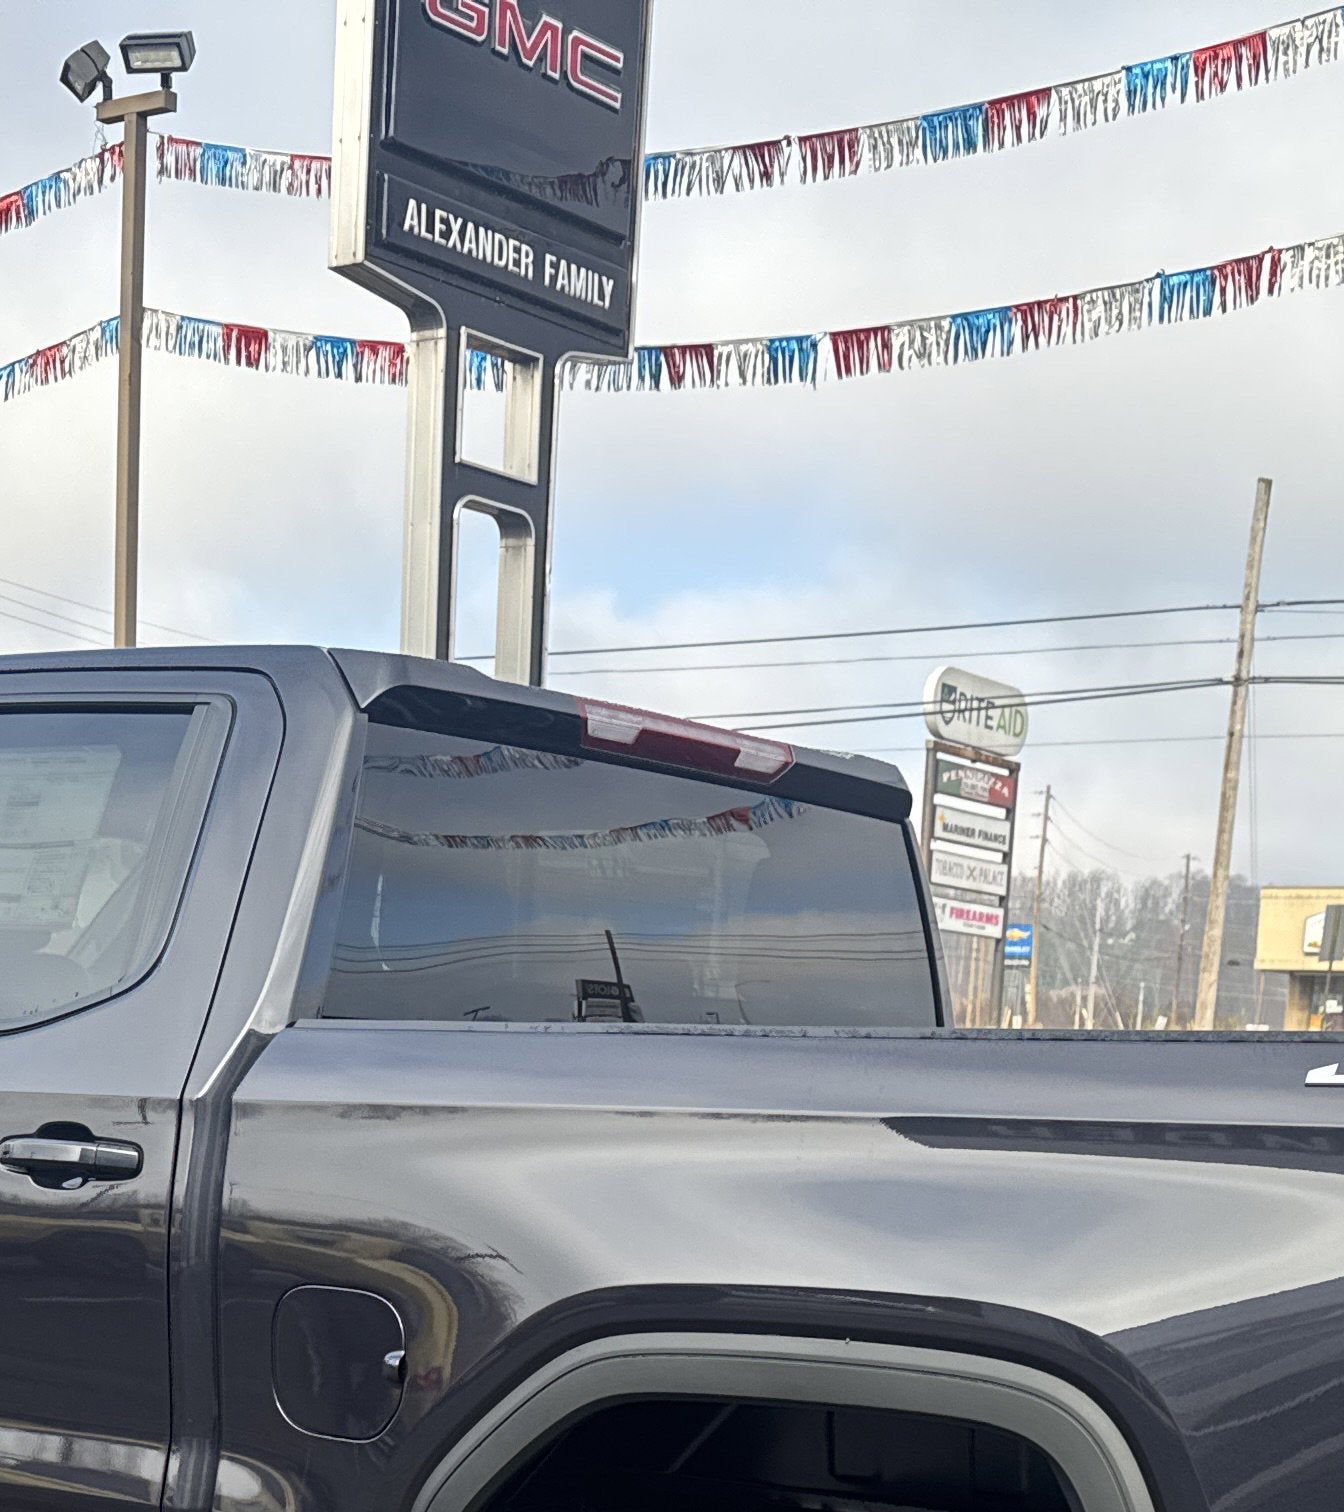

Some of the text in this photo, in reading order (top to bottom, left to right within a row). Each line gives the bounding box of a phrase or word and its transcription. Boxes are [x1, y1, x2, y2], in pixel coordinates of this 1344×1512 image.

[424, 0, 623, 110] GMC
[402, 198, 614, 309] ALEXANDER FAMILY
[957, 692, 1025, 738] RITE AID
[942, 822, 976, 839] MARINER
[949, 907, 1000, 926] FIREARMS
